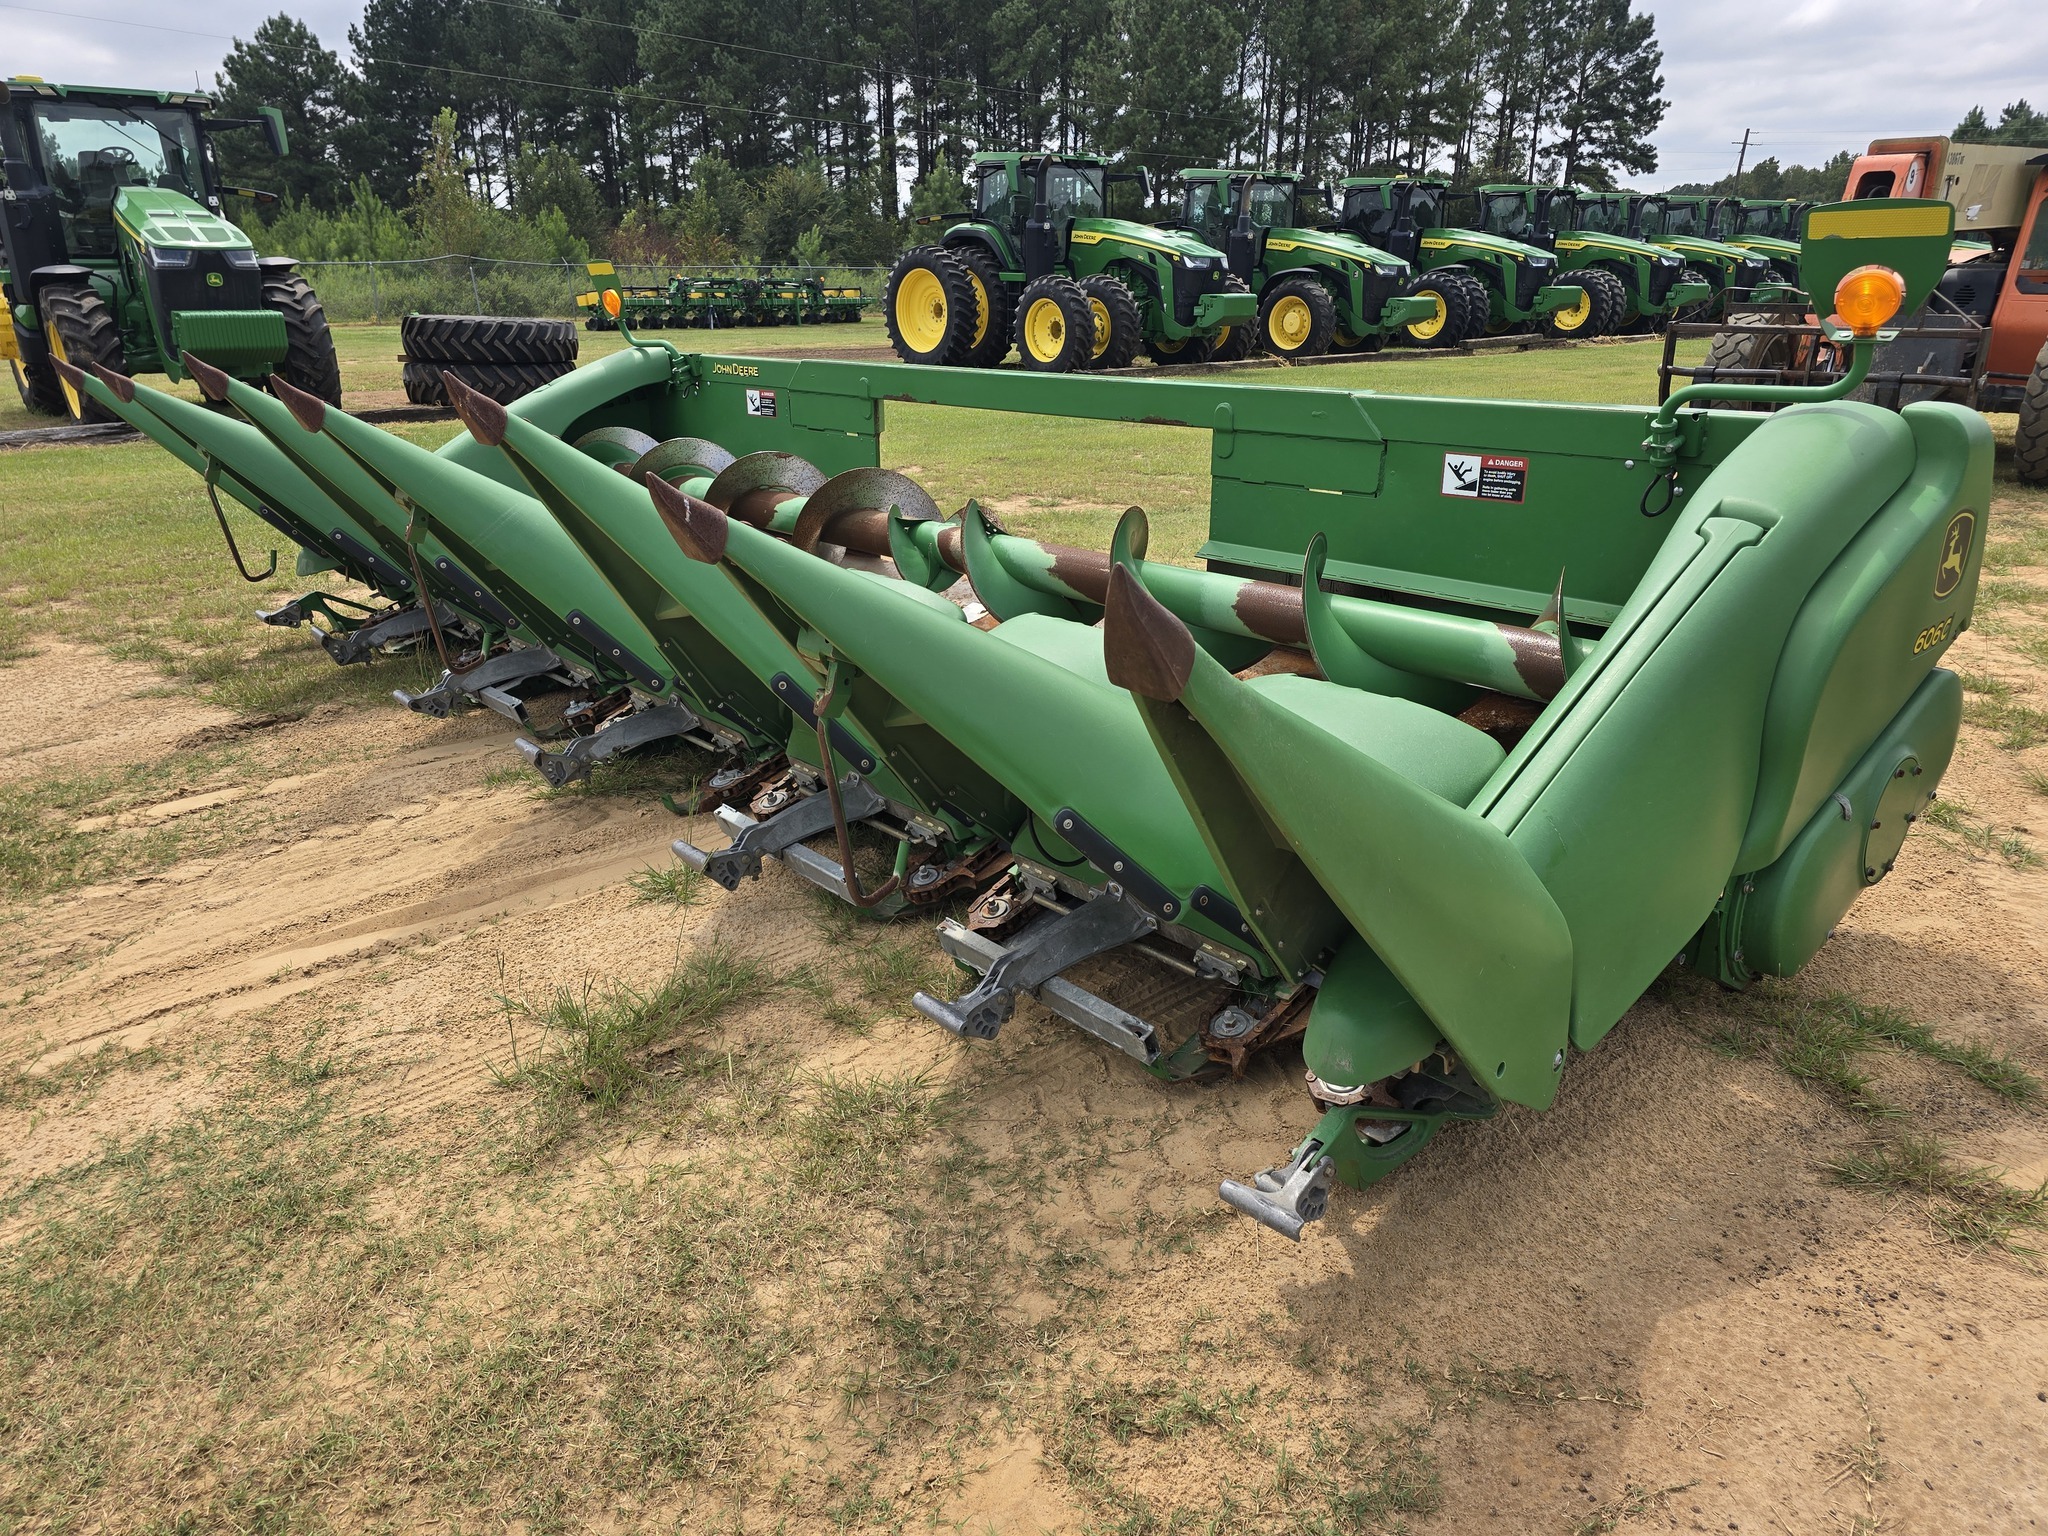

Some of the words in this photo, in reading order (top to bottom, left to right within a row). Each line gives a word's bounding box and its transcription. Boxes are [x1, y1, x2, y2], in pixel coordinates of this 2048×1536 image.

[713, 362, 732, 374] JOHN
[732, 363, 759, 377] DEERE
[1495, 459, 1524, 468] DANGER
[1913, 616, 1953, 656] 606C
